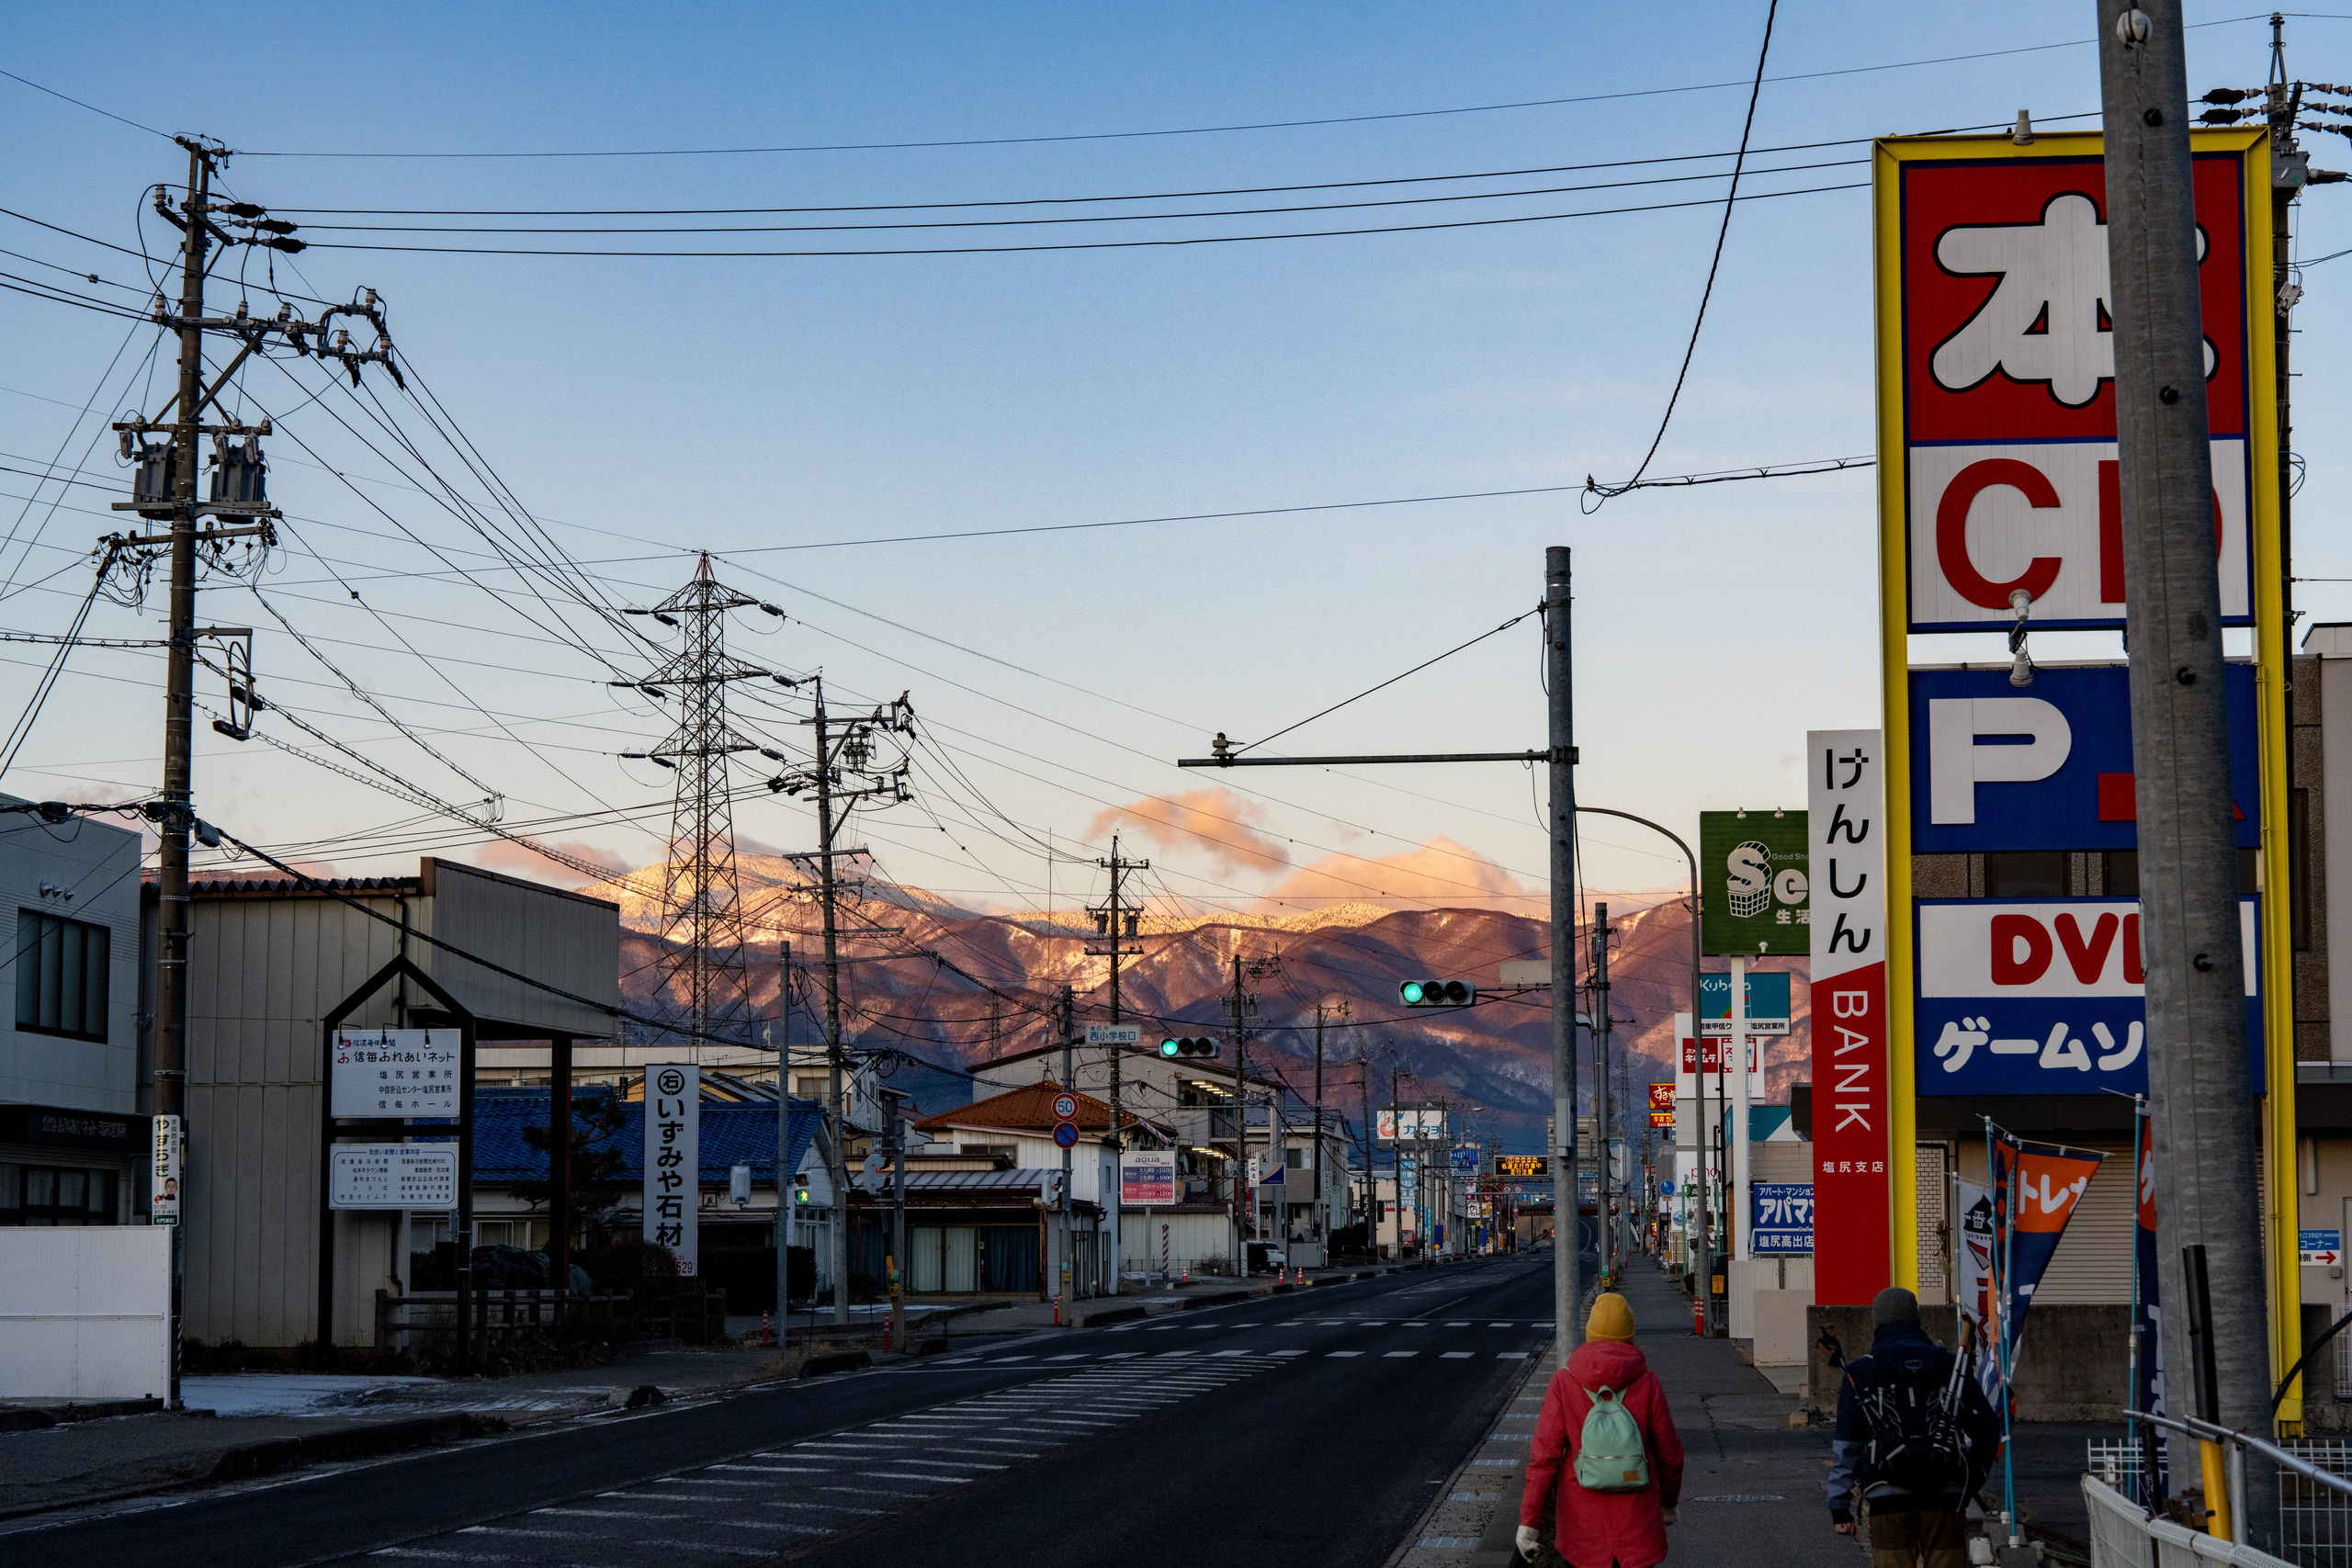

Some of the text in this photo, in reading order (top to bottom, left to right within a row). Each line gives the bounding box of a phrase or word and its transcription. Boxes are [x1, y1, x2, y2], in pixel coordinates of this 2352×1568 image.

[1929, 190, 2221, 409] 本
[1936, 458, 2222, 610] C
[1825, 748, 1871, 954] けんしん
[353, 1038, 396, 1047] 信濃毎日聞
[1090, 1031, 1136, 1042] 西小学校口
[1933, 1015, 2144, 1074] ゲームソ
[354, 1051, 456, 1063] 信毎ふれあいネット
[1832, 989, 1871, 1134] BANK
[379, 1069, 453, 1079] 塩尻営業所
[379, 1085, 453, 1094] 中信折込センター塩尻営業所
[379, 1100, 452, 1110] 信毎ホール
[1057, 1100, 1073, 1113] 50
[155, 1118, 170, 1178] やすらぎ
[655, 1099, 684, 1247] いずみや石材
[1822, 1160, 1884, 1174] 塩尻支店
[1758, 1235, 1815, 1248] 塩尻高出店
